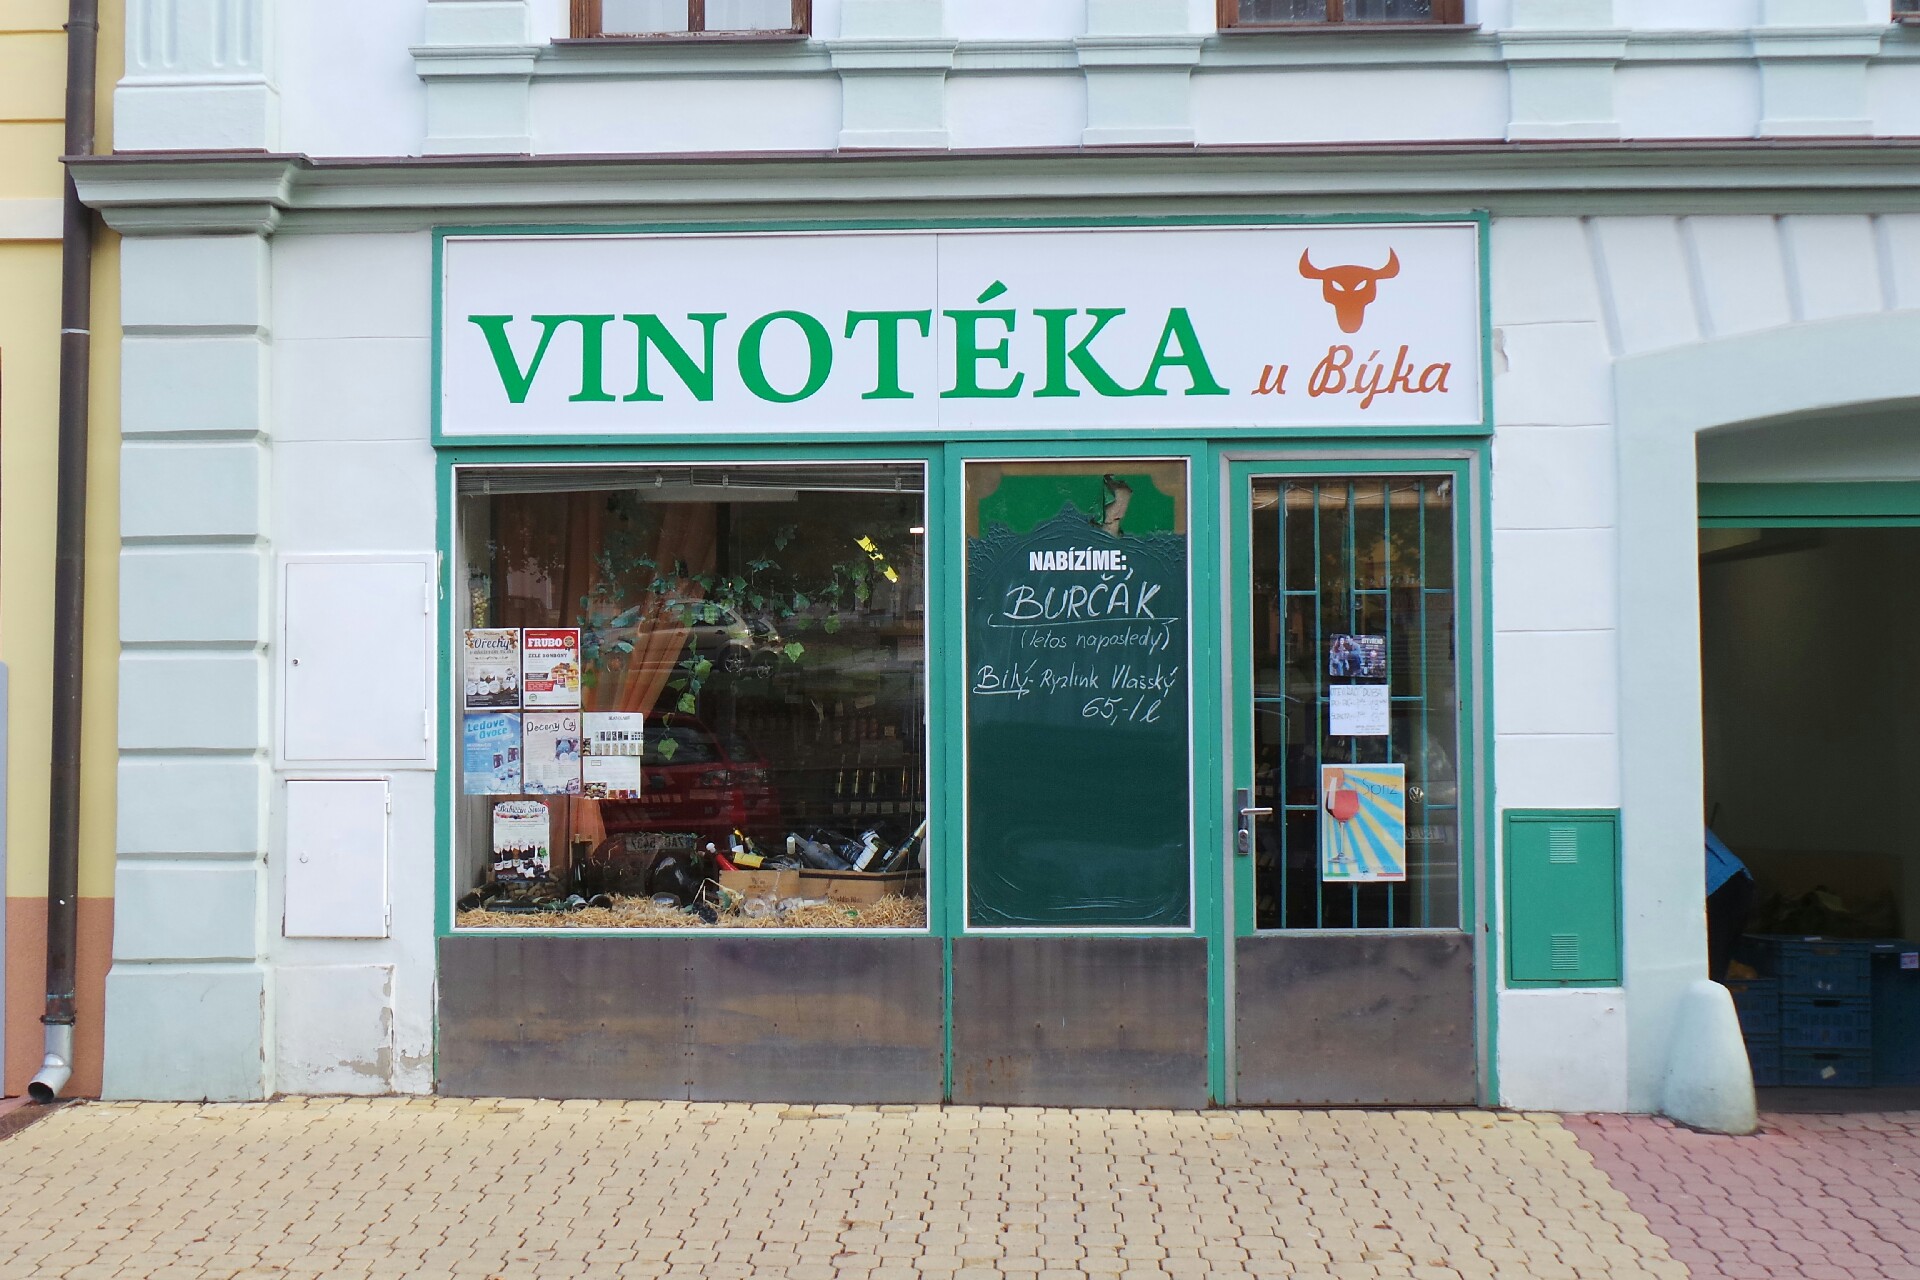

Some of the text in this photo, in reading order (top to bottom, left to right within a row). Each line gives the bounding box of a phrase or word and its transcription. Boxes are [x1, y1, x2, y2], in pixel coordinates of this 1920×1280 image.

[467, 280, 1230, 403] VINOTÉKA
[1251, 344, 1451, 410] u Býka
[1029, 547, 1127, 571] NABÍZÍME:
[1003, 568, 1161, 619] BURČÁK
[527, 638, 563, 648] FRUBO
[1076, 625, 1170, 655] naposledy)
[1039, 662, 1099, 695] Ryzlink
[1111, 664, 1179, 698] Vlašský
